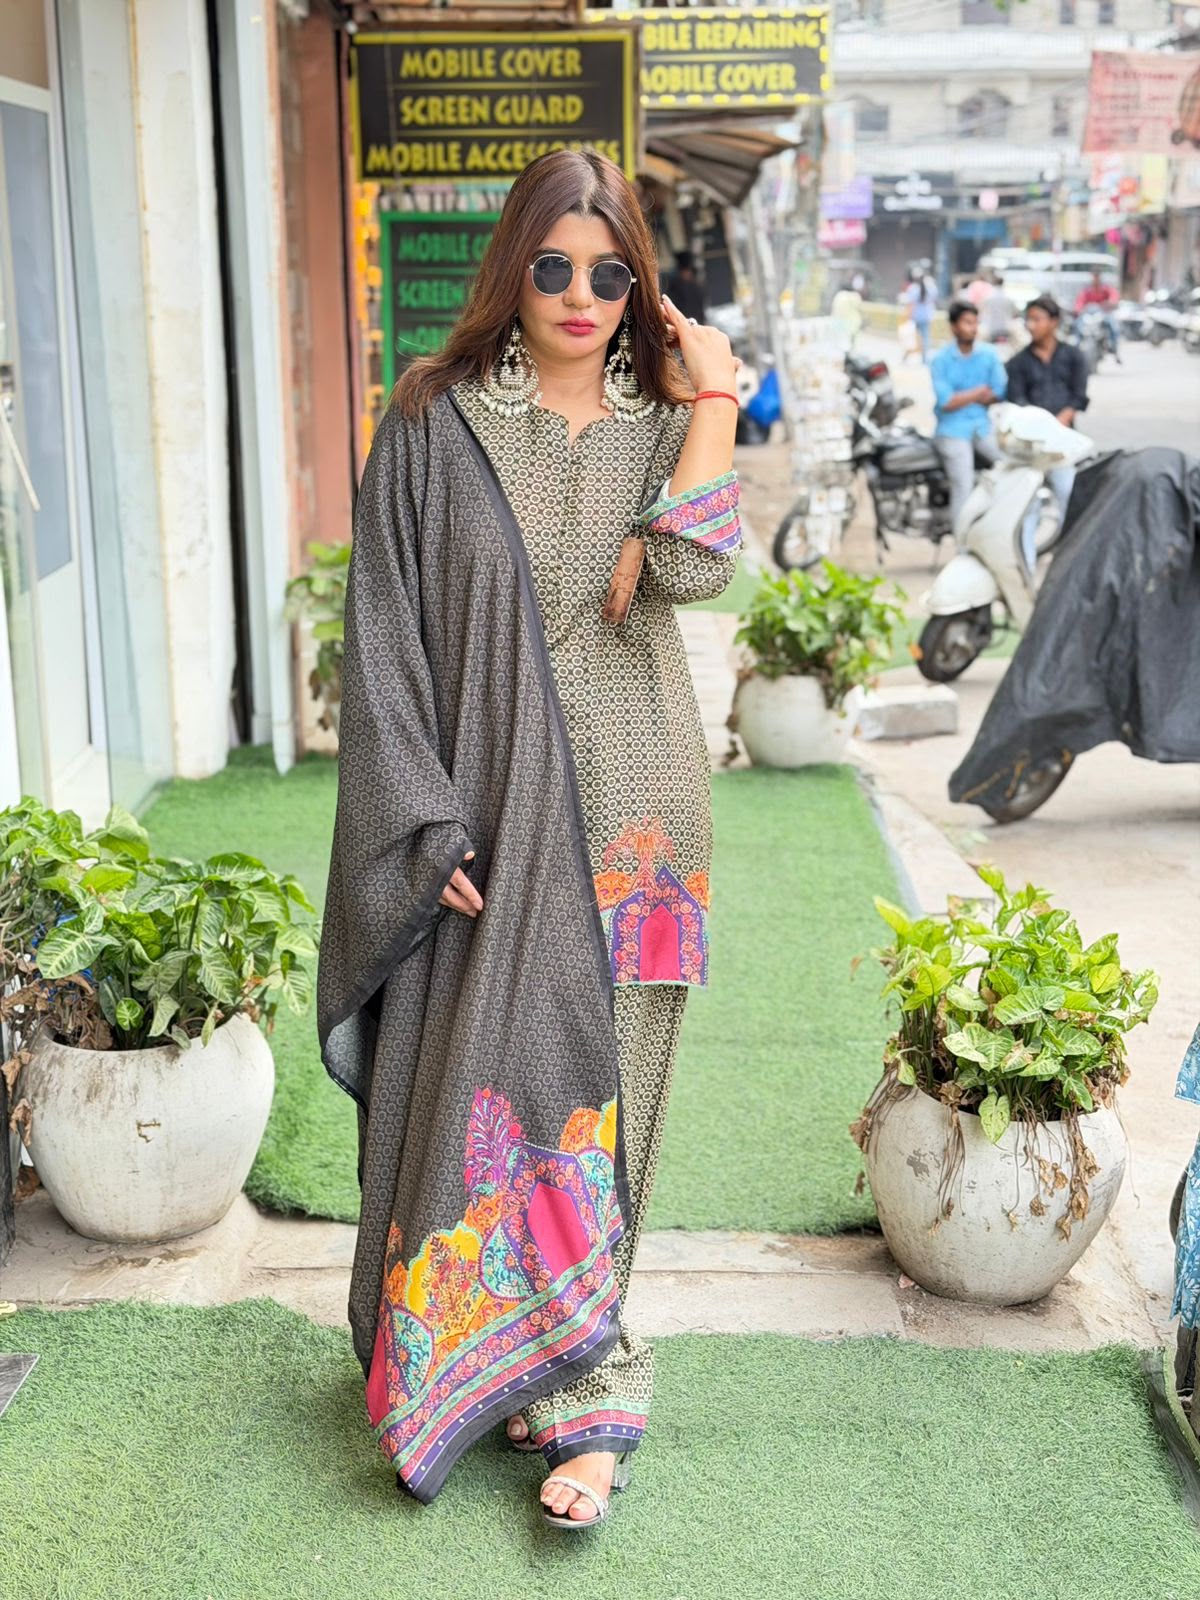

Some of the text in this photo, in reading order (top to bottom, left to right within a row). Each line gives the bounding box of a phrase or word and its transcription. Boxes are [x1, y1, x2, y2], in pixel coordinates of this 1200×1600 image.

[642, 21, 821, 51] BILE REPAIRING
[400, 47, 582, 78] MOBILE COVER
[719, 62, 797, 92] COVER
[400, 94, 584, 126] SCREEN GUARD
[366, 142, 462, 172] MOBILE
